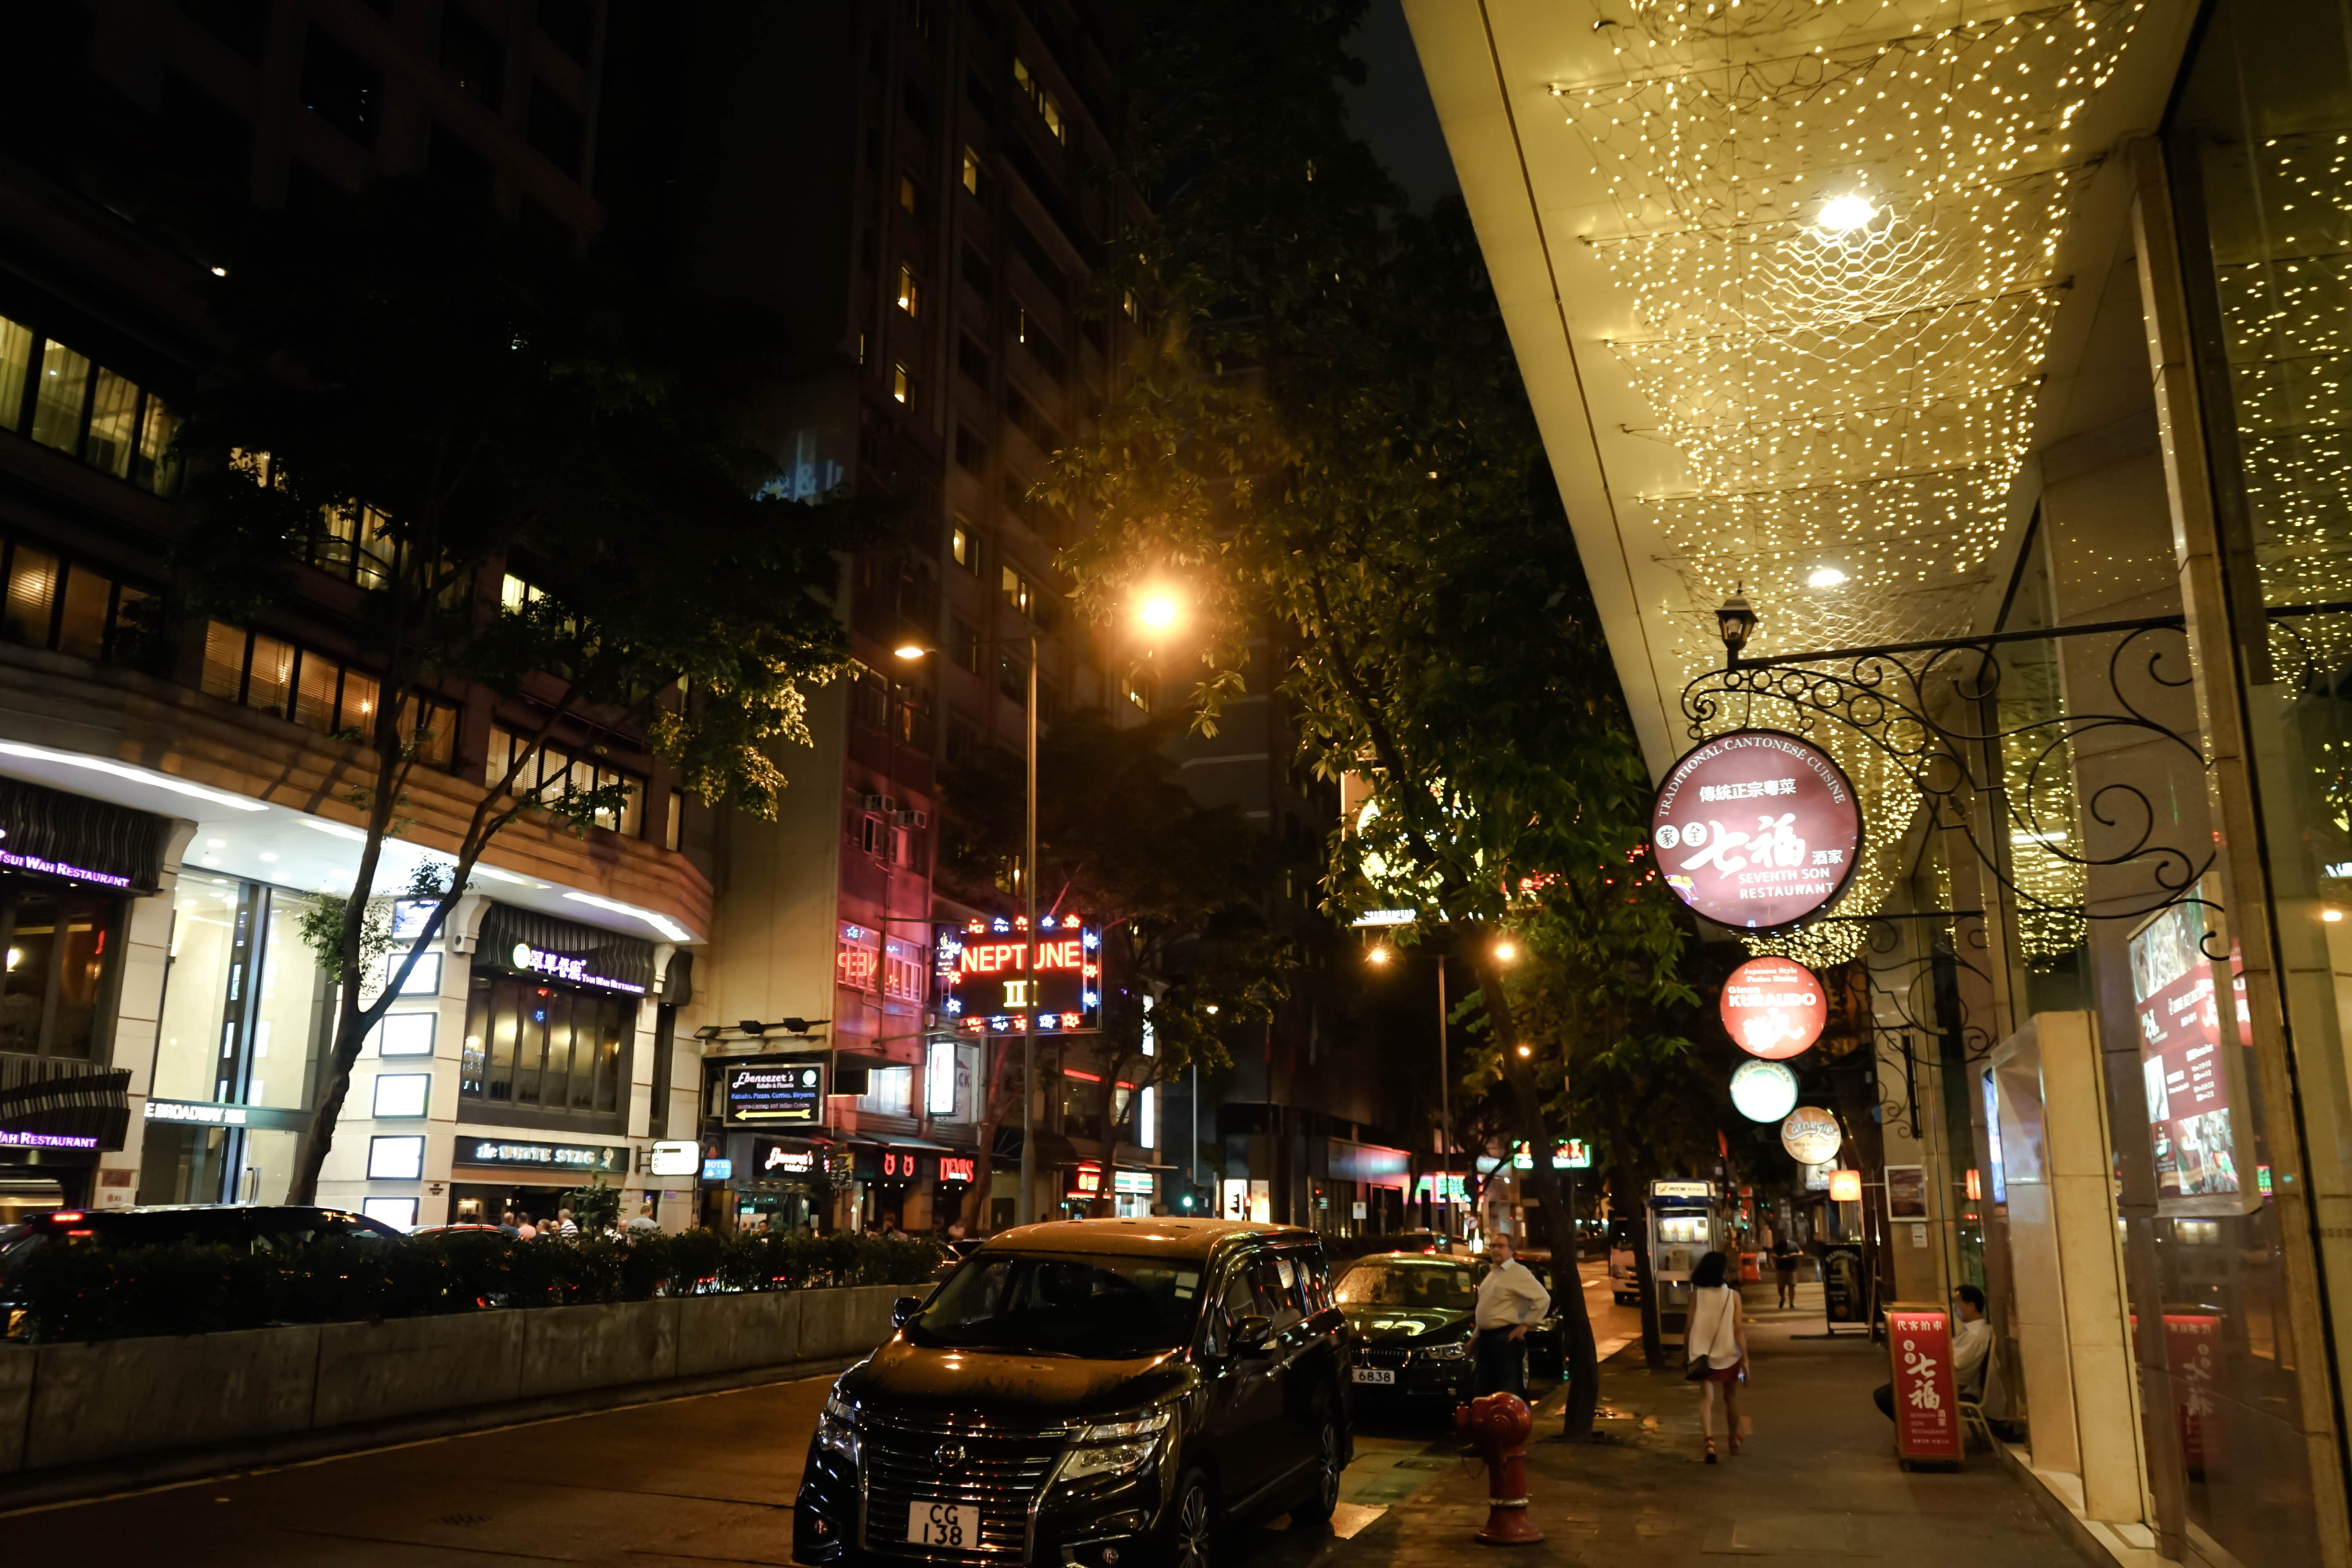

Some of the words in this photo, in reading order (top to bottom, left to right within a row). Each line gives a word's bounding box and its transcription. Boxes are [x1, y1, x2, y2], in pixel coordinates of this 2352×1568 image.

[1659, 746, 1722, 817] TRADITIONAL
[1724, 737, 1807, 760] CANTONESE
[1807, 757, 1846, 804] CUISINE
[1812, 849, 1843, 865] 酒家
[26, 856, 55, 873] WAH
[56, 863, 129, 887] RESTAURANT
[1739, 870, 1797, 884] SEVENTH
[1802, 867, 1830, 879] SON
[1740, 882, 1835, 899] RESTAURANT
[961, 941, 1080, 973] NEPTUNE
[1729, 993, 1817, 1007] KURAUDO
[732, 1071, 794, 1089] Ebeneezer's
[1744, 1063, 1774, 1073] CANNY
[1775, 1066, 1790, 1082] MAN
[154, 1103, 224, 1122] BROADWAY
[20, 1132, 97, 1148] RESTAURANT
[499, 1145, 552, 1161] WHITE
[555, 1149, 595, 1164] STAG
[1897, 1320, 1943, 1331] 代客泊車
[1359, 1371, 1390, 1382] 6838
[929, 1504, 958, 1526] CG
[924, 1523, 962, 1546] 138
